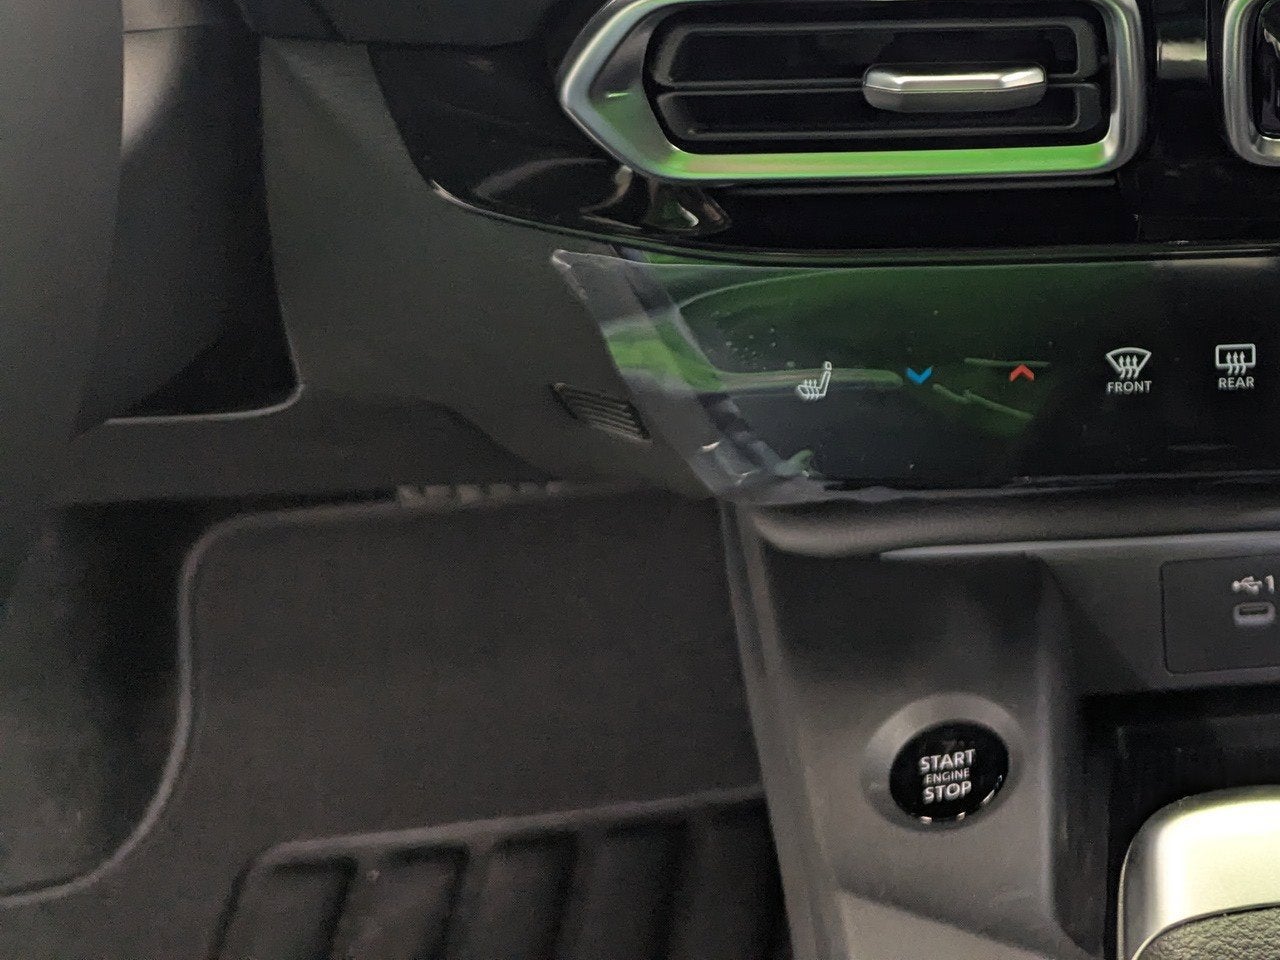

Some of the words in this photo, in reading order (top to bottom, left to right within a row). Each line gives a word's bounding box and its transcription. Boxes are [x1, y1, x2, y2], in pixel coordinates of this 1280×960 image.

[1107, 380, 1152, 393] FRONT
[1218, 376, 1255, 389] REAR
[1264, 575, 1275, 594] 1
[919, 748, 976, 773] START
[925, 767, 970, 784] ENGINE
[923, 780, 972, 804] STOP
